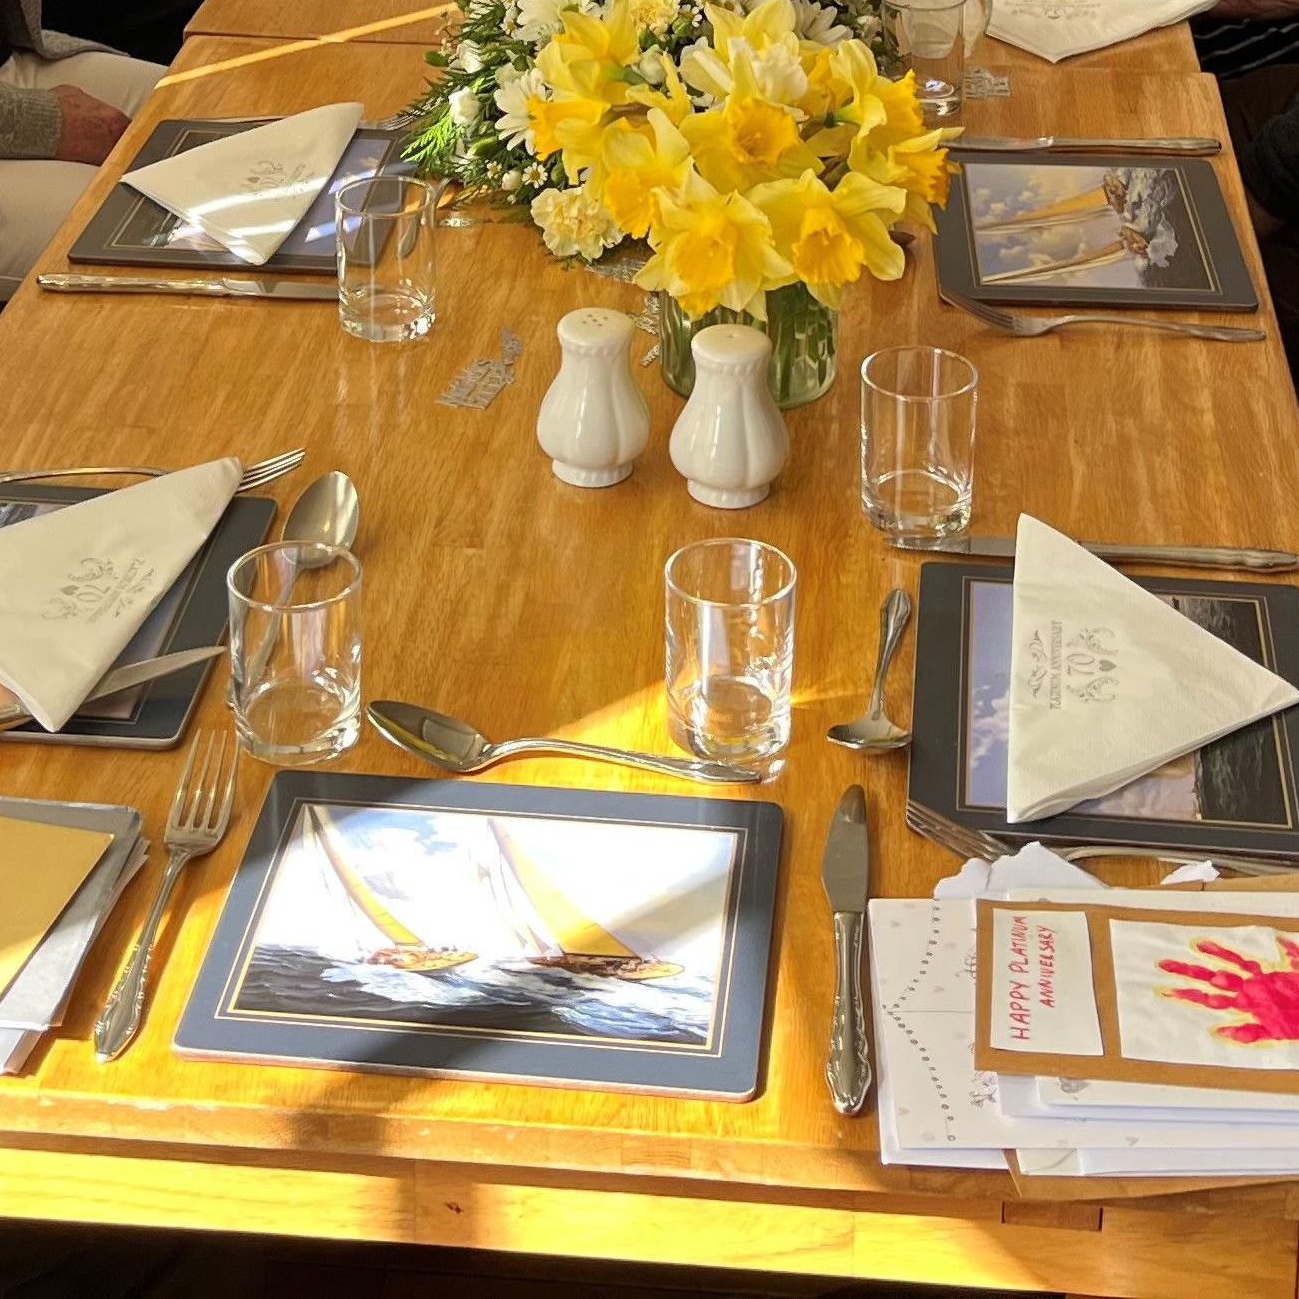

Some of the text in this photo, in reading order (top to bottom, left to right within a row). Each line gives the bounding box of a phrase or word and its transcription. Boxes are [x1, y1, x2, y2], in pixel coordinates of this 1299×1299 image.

[1065, 653, 1096, 678] 70
[1008, 916, 1031, 1040] HAPPY PLATINUM
[1037, 925, 1058, 1008] ANNIVERSARY
